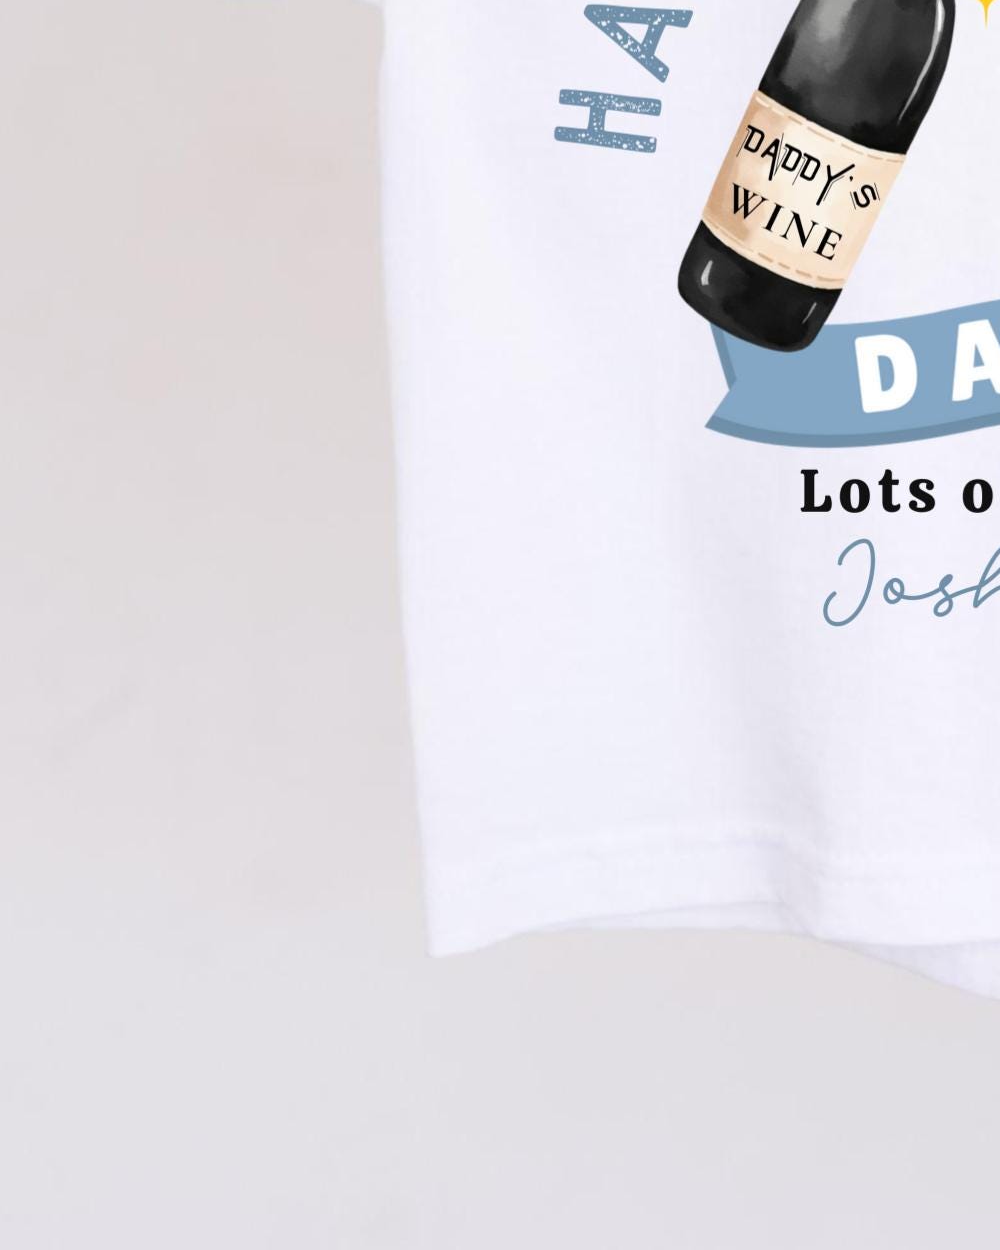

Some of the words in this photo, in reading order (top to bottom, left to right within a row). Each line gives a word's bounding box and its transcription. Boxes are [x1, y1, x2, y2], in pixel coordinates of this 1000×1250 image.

[736, 125, 880, 210] DADDY'S
[732, 183, 843, 260] WINE
[800, 469, 936, 513] Lots
